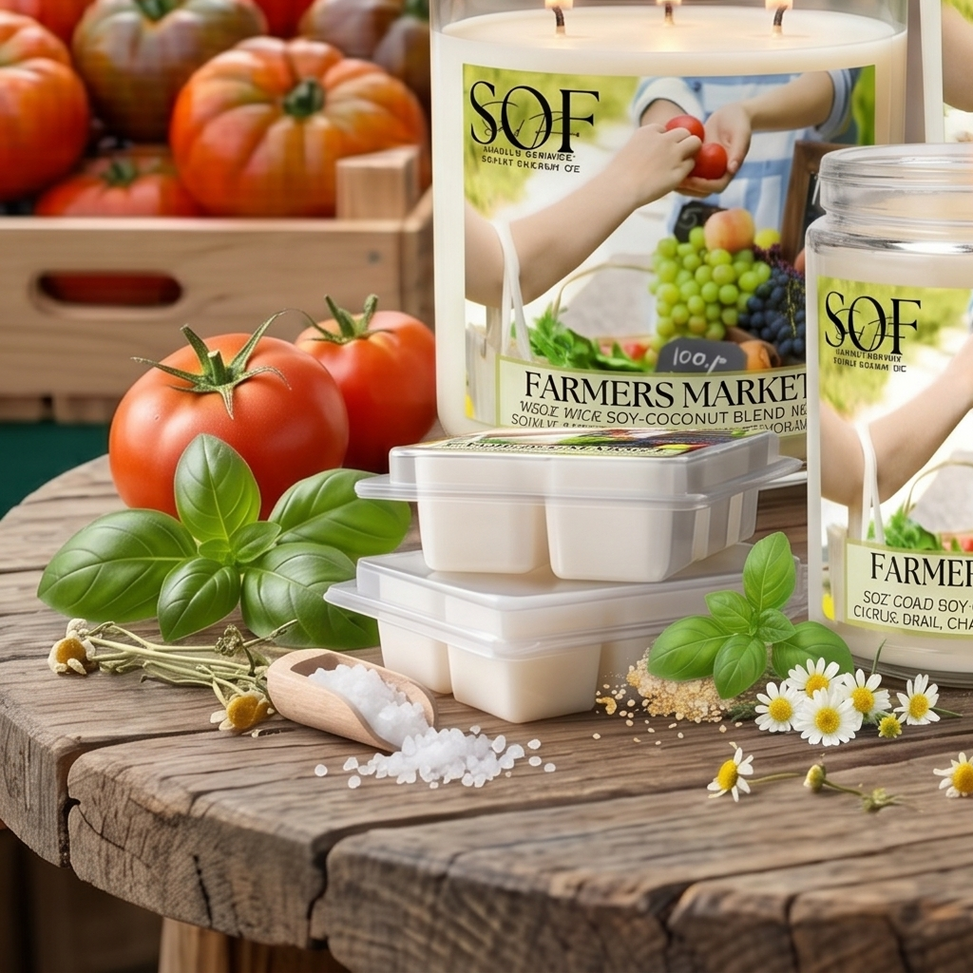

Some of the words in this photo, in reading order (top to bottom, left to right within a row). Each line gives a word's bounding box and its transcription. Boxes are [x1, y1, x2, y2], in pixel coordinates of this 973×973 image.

[469, 80, 600, 153] SOF
[824, 291, 922, 356] SOF
[525, 370, 674, 409] FARMERS
[606, 411, 729, 426] SOY-COCONUT
[733, 407, 785, 424] BLEND
